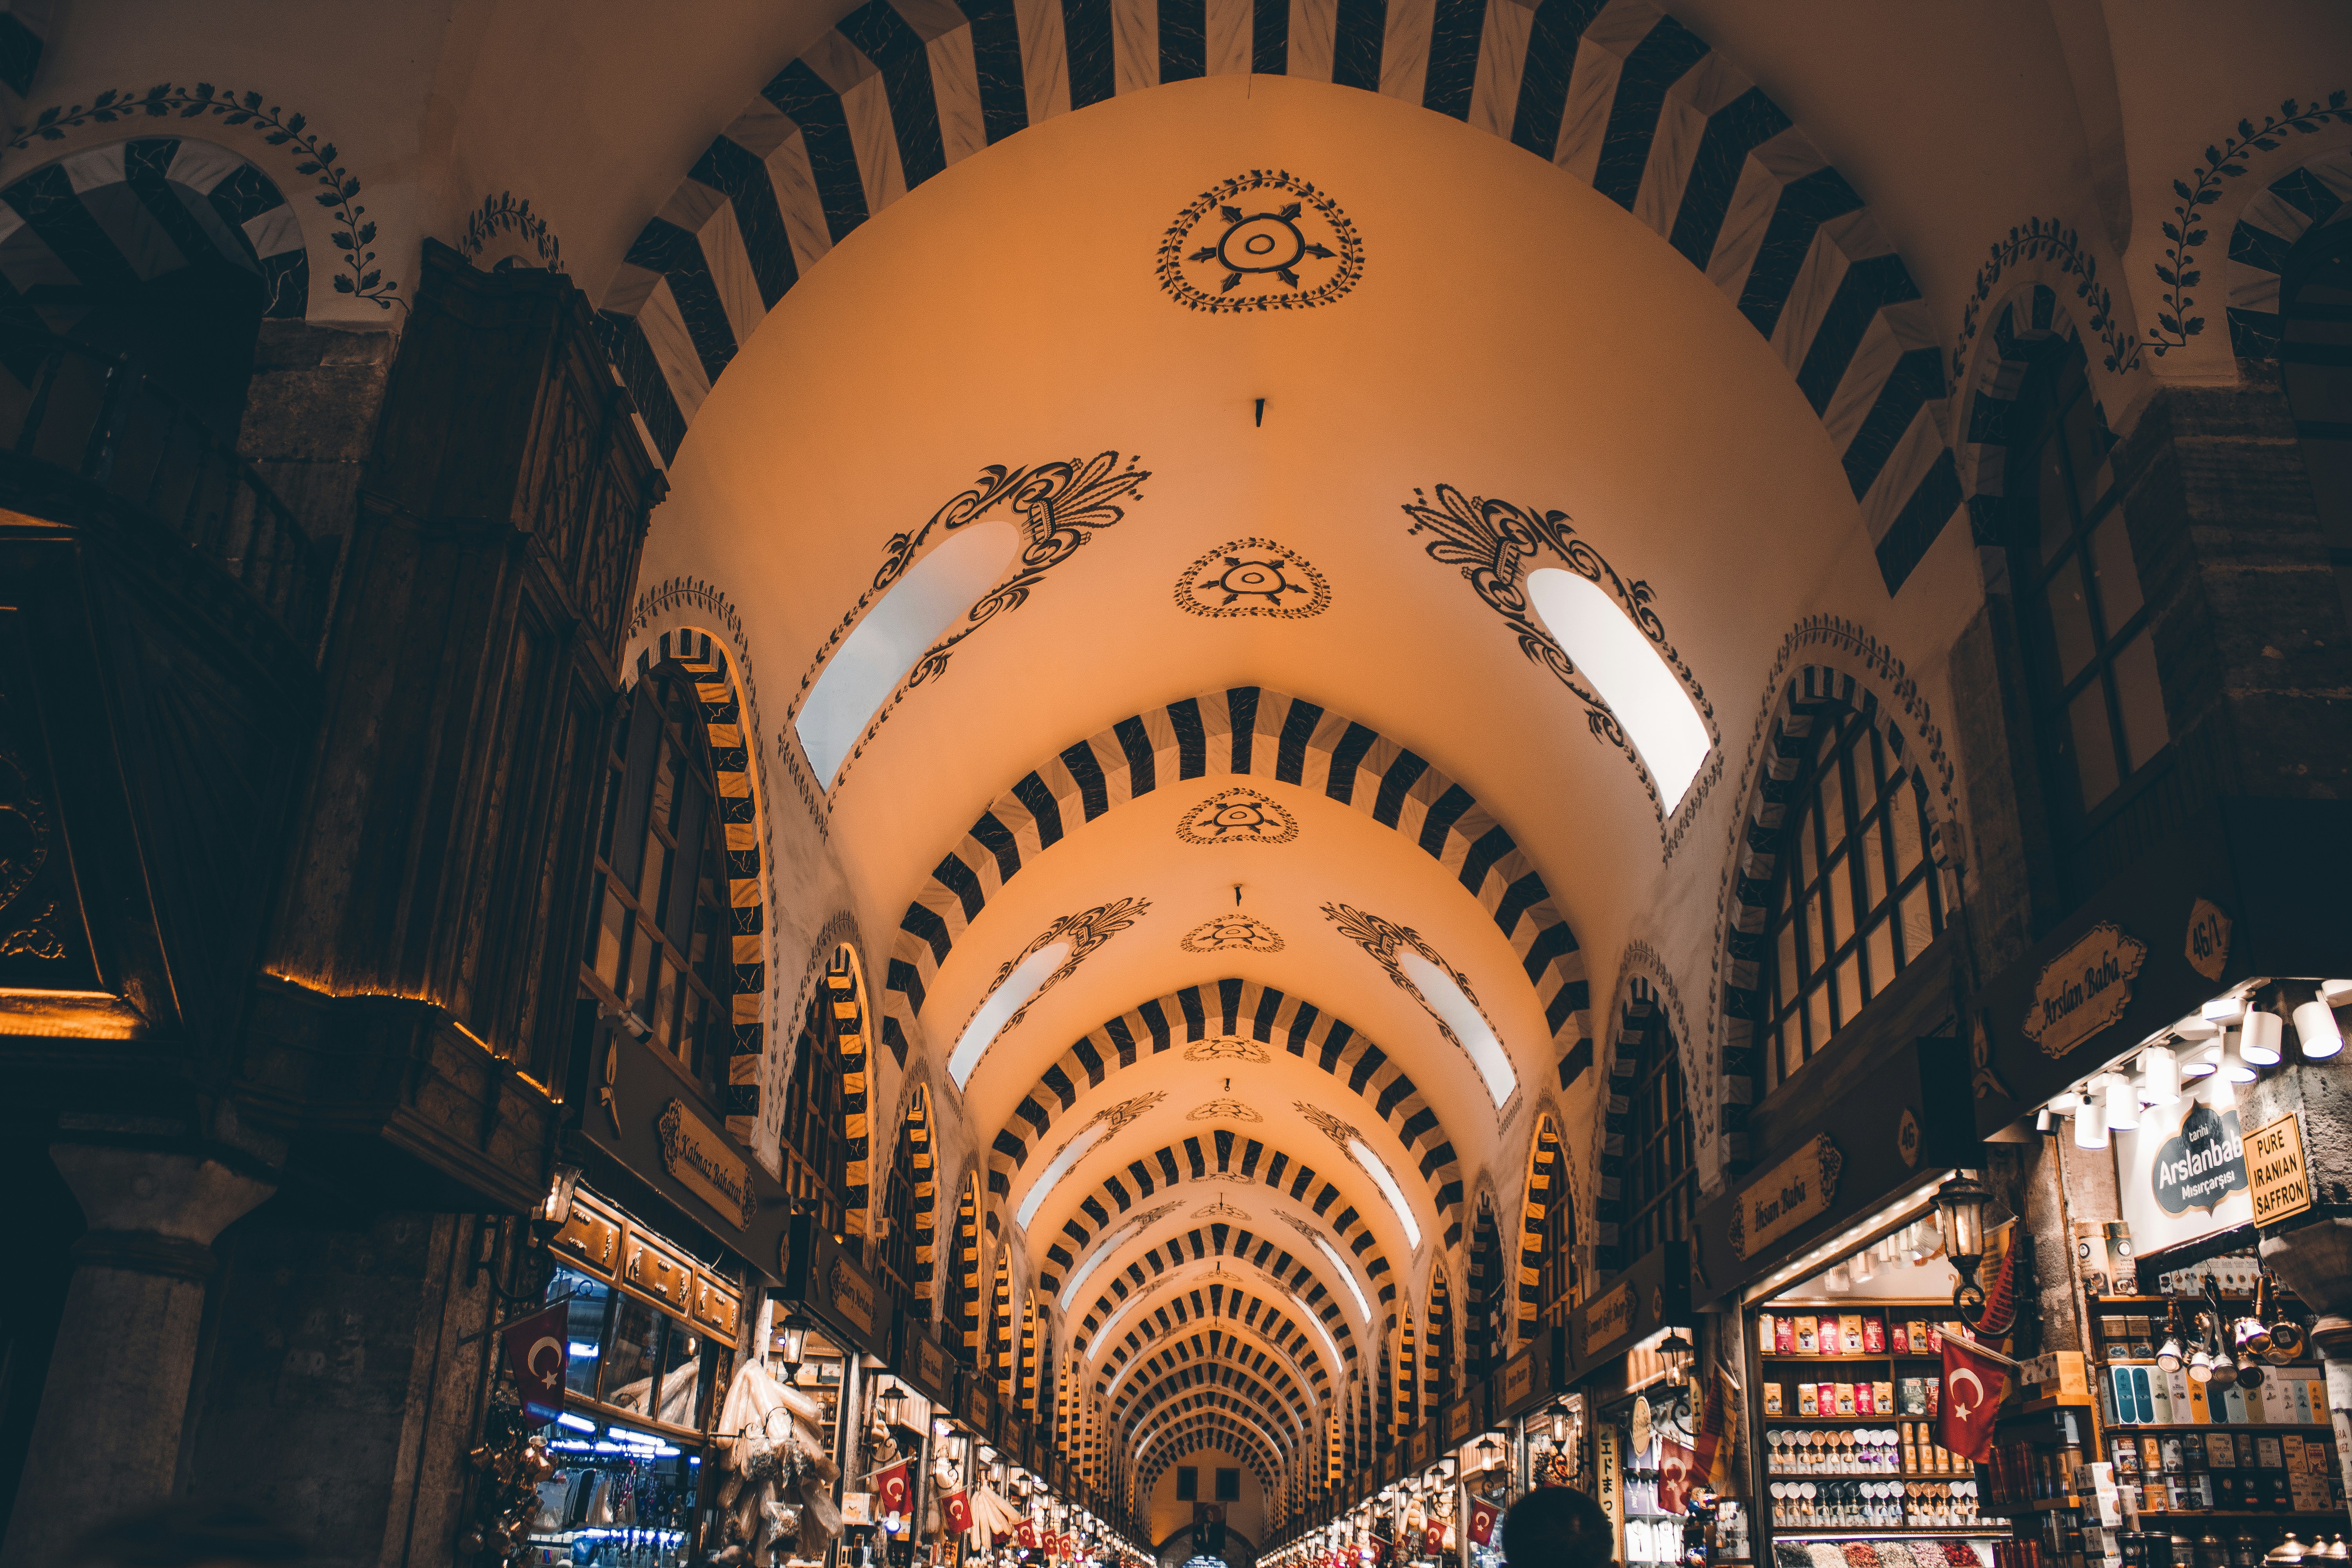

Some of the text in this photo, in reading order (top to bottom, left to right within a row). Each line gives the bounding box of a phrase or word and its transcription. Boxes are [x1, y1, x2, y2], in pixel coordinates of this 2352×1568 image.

[2193, 913, 2221, 960] 46/1
[2042, 950, 2118, 1030] Arslan Baba
[1902, 1122, 1915, 1150] 46
[2189, 1123, 2209, 1142] tarihi
[2257, 1129, 2285, 1158] PURE
[2253, 1152, 2298, 1188] IRANIAN
[1781, 1175, 1806, 1214] Baba
[2257, 1180, 2304, 1215] SAFFRON
[1902, 1386, 1922, 1394] TEA
